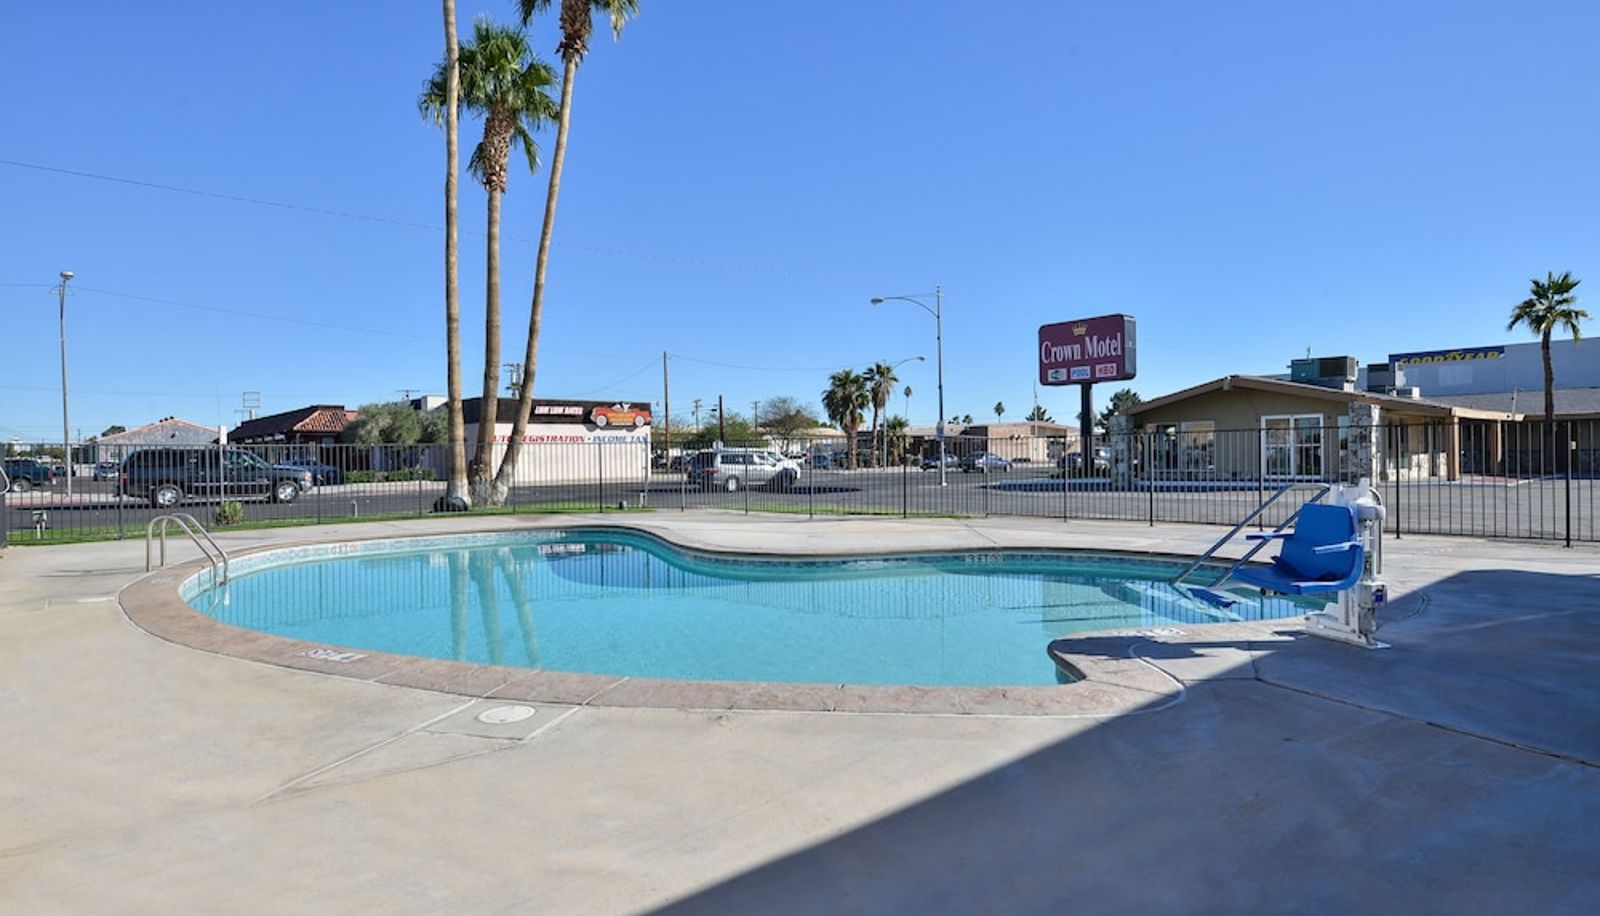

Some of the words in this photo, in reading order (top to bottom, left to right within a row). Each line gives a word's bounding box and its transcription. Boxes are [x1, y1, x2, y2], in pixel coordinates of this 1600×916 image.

[1041, 341, 1081, 363] Crown
[1084, 332, 1122, 359] Motel
[521, 435, 585, 444] EGISTRATION
